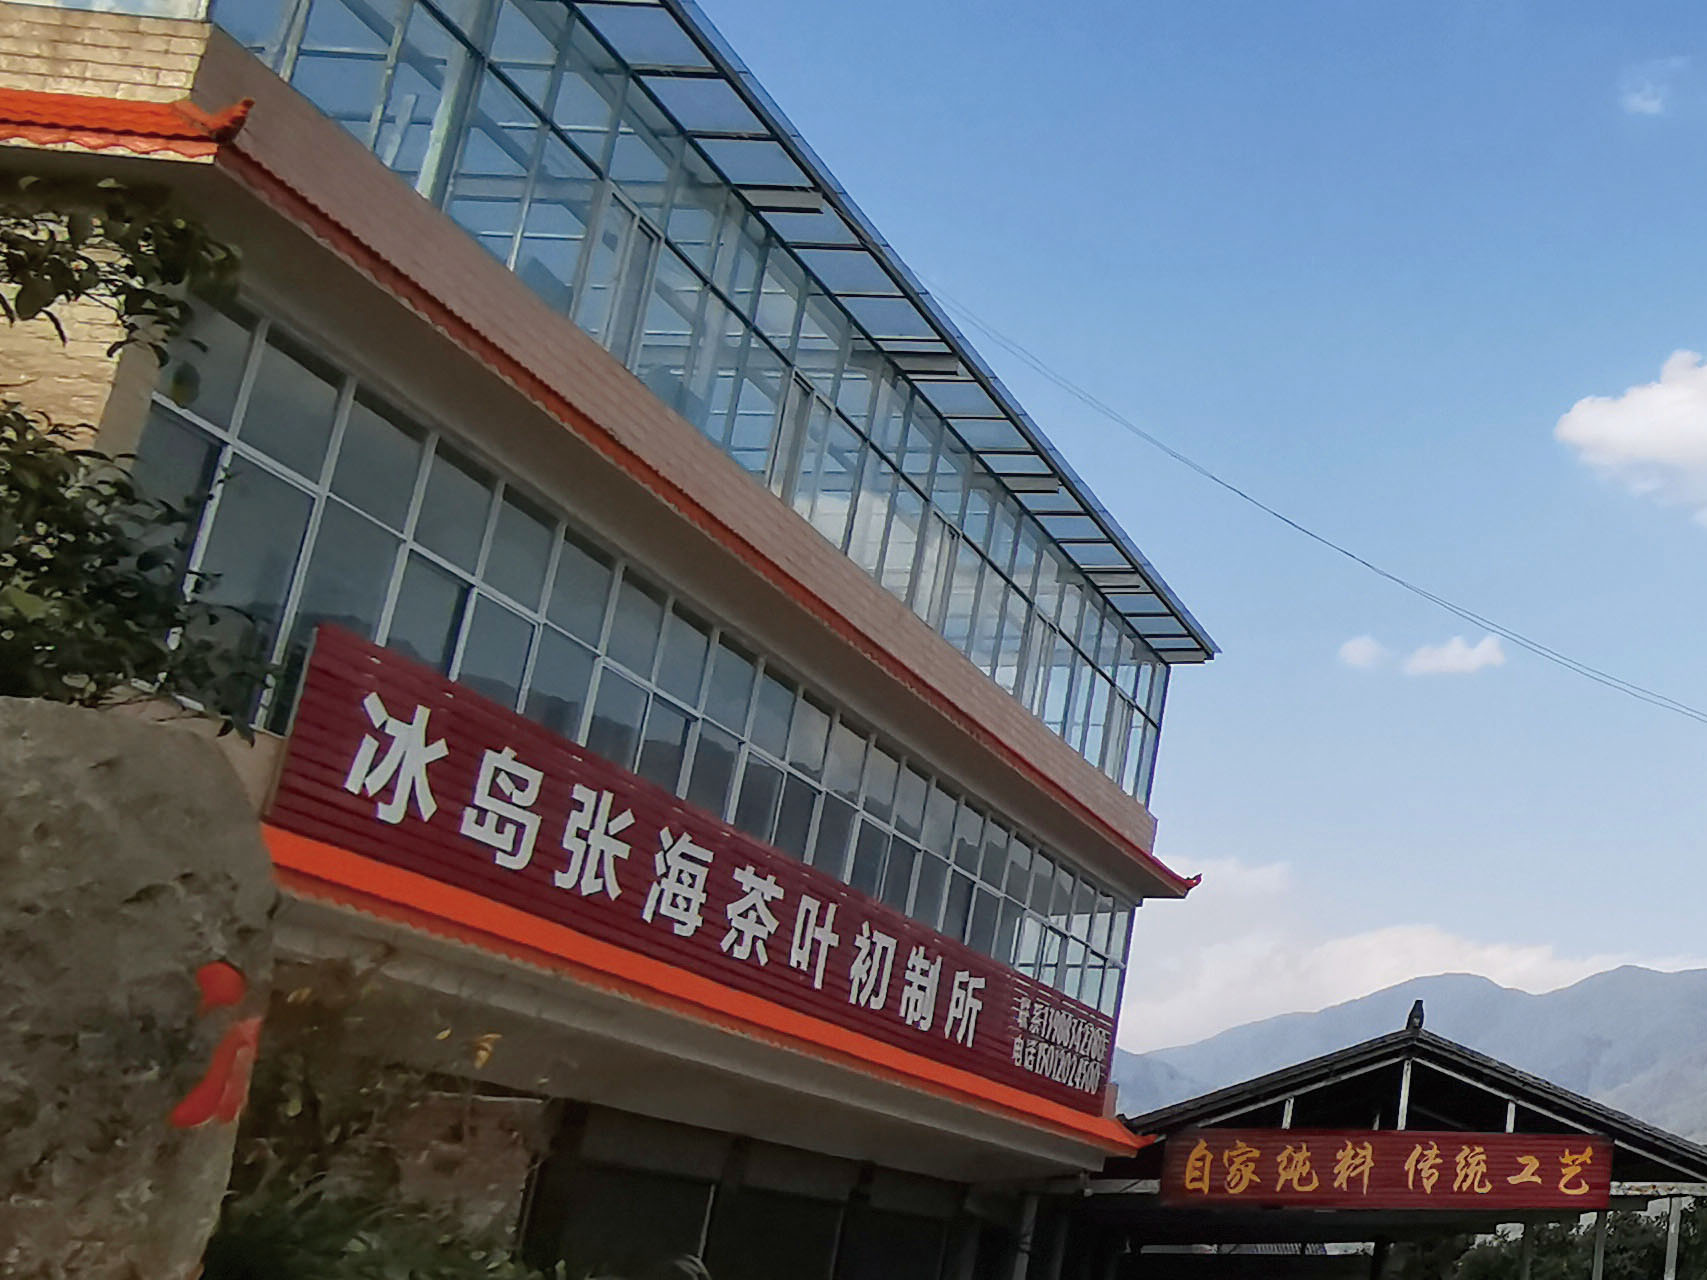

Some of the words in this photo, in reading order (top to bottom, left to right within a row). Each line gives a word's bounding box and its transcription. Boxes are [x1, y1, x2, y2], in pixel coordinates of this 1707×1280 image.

[344, 691, 987, 1048] 冰岛张海茶叶初制所
[1185, 1139, 1374, 1195] 自家纯料
[1404, 1141, 1593, 1195] 传统工艺
